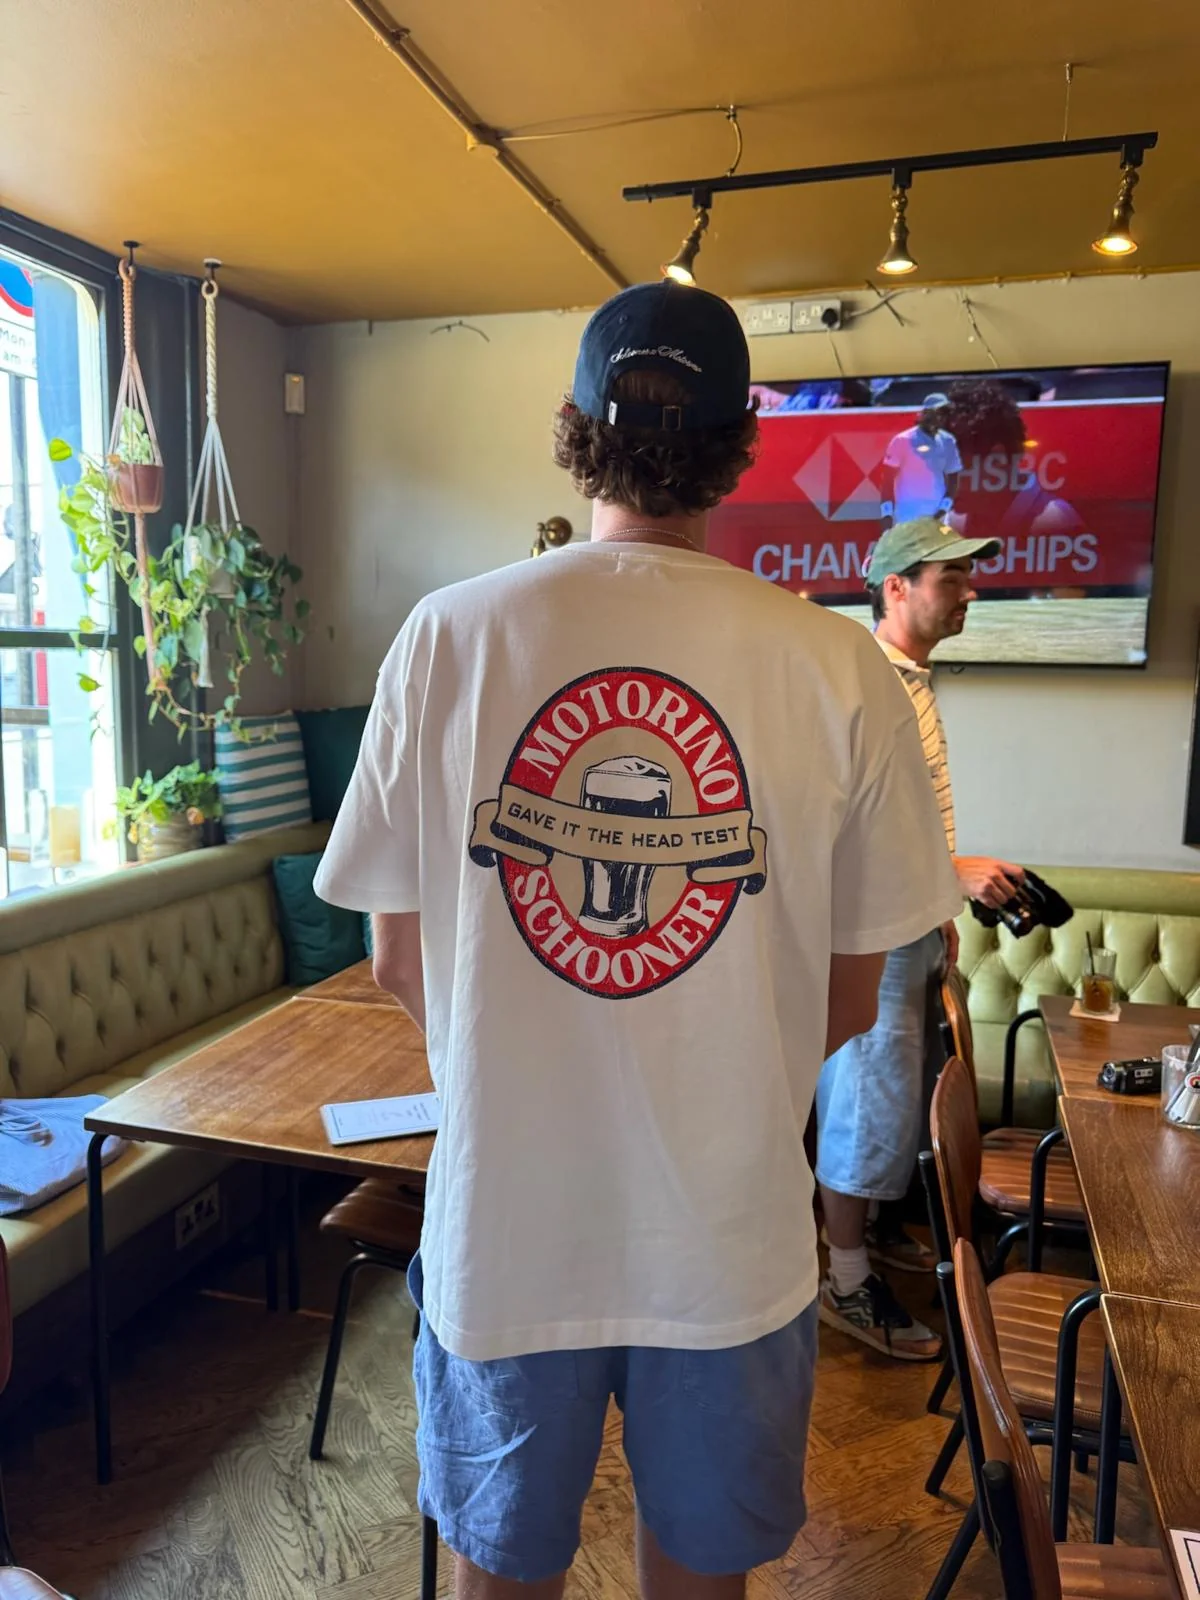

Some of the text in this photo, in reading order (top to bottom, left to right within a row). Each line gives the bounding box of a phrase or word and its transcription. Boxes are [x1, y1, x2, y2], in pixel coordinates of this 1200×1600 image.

[956, 452, 1067, 492] HSBC
[753, 533, 1098, 581] CHAMSHIPS
[519, 680, 739, 805] MOTORINO
[508, 802, 740, 848] GAVE IT THE HEAD TEST
[513, 869, 725, 988] SCHOONER
